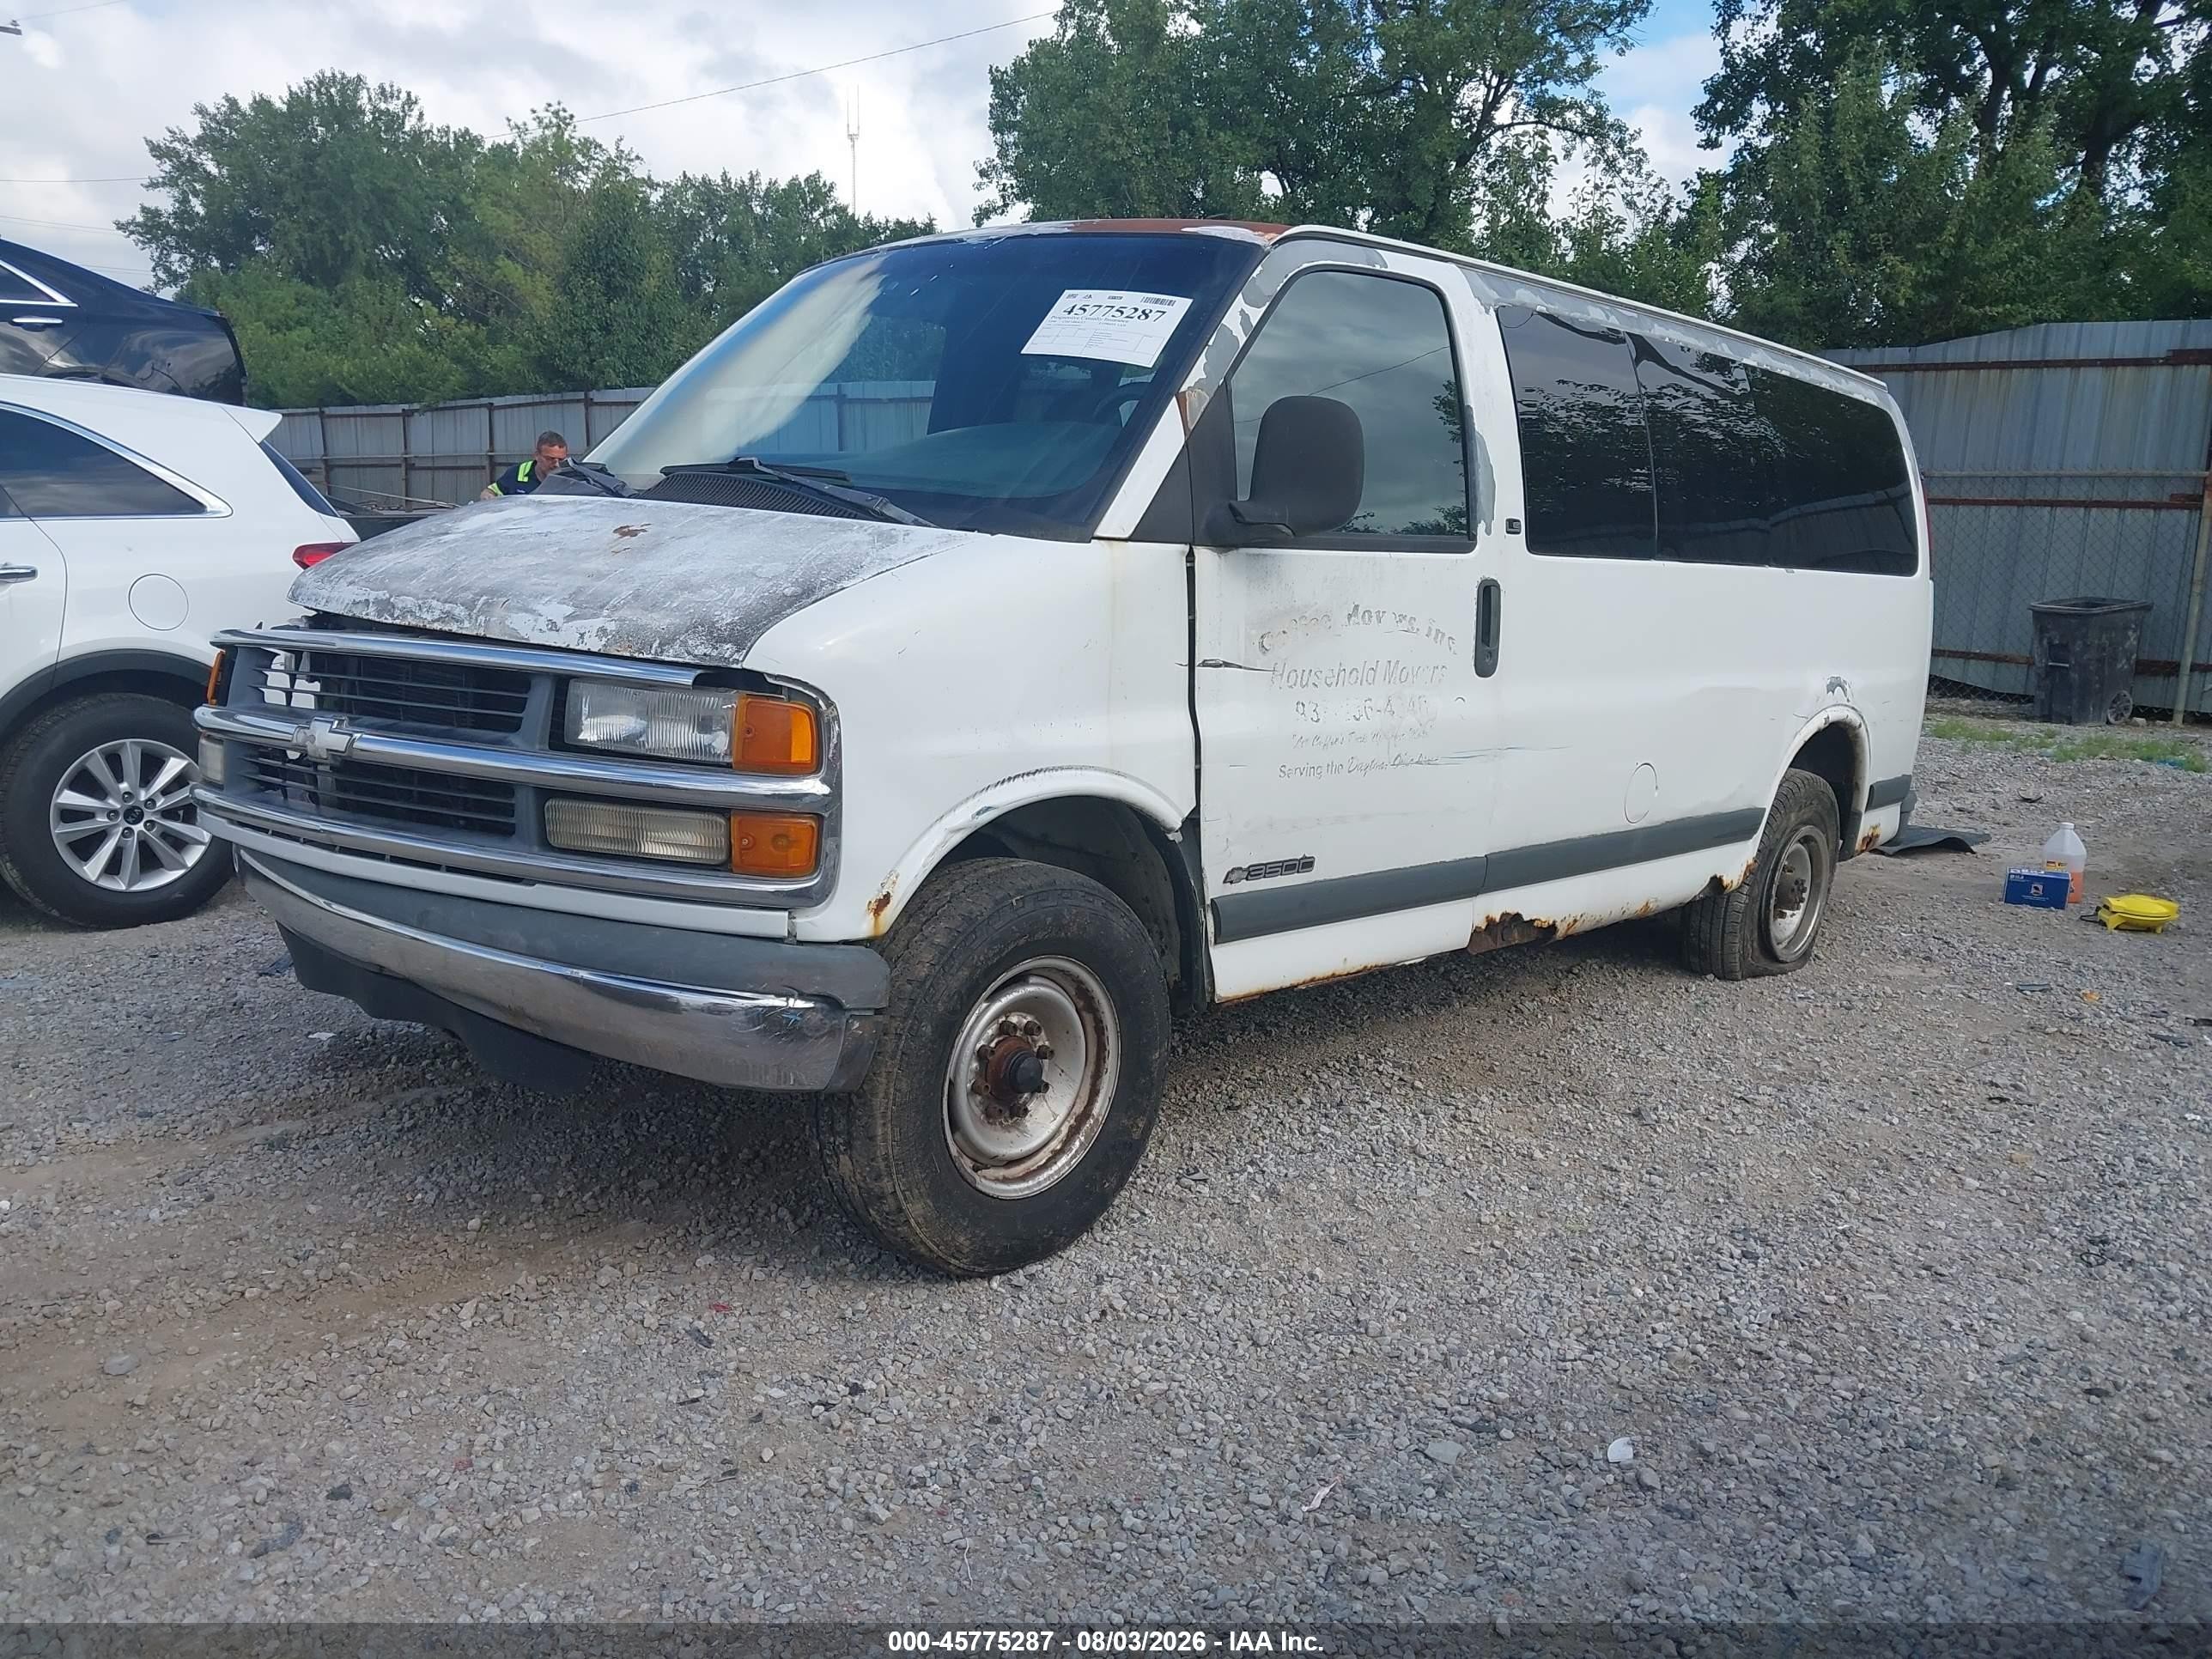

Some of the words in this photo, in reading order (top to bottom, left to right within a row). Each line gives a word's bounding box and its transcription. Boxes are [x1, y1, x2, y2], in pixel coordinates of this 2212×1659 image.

[1063, 304, 1168, 322] 45775287
[1271, 659, 1380, 690] Household
[1278, 763, 1322, 781] Serving
[1326, 761, 1344, 775] the
